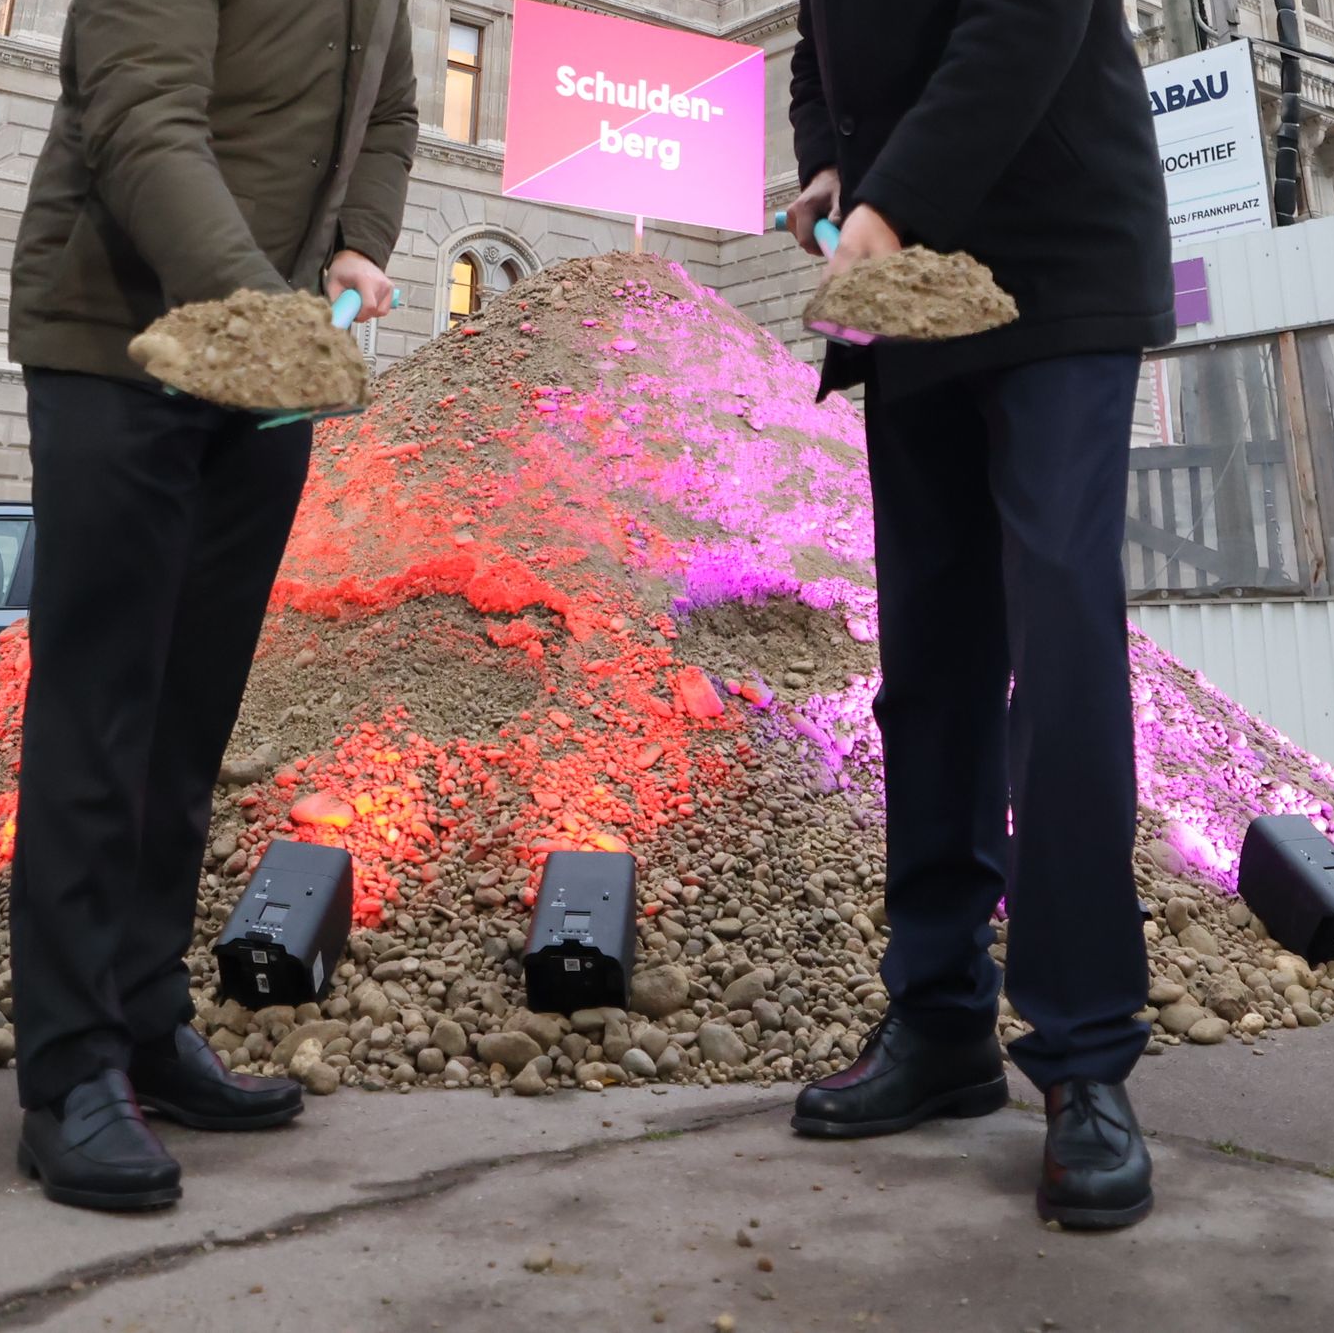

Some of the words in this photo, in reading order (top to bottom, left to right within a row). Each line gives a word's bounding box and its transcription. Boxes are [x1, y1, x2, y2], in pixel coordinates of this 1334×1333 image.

[555, 65, 724, 122] Schulden-
[1149, 70, 1229, 116] ABAU
[599, 120, 681, 170] berg
[1161, 141, 1236, 173] OCHTIEF
[1168, 198, 1260, 225] AUS/FRANKHPLATZ
